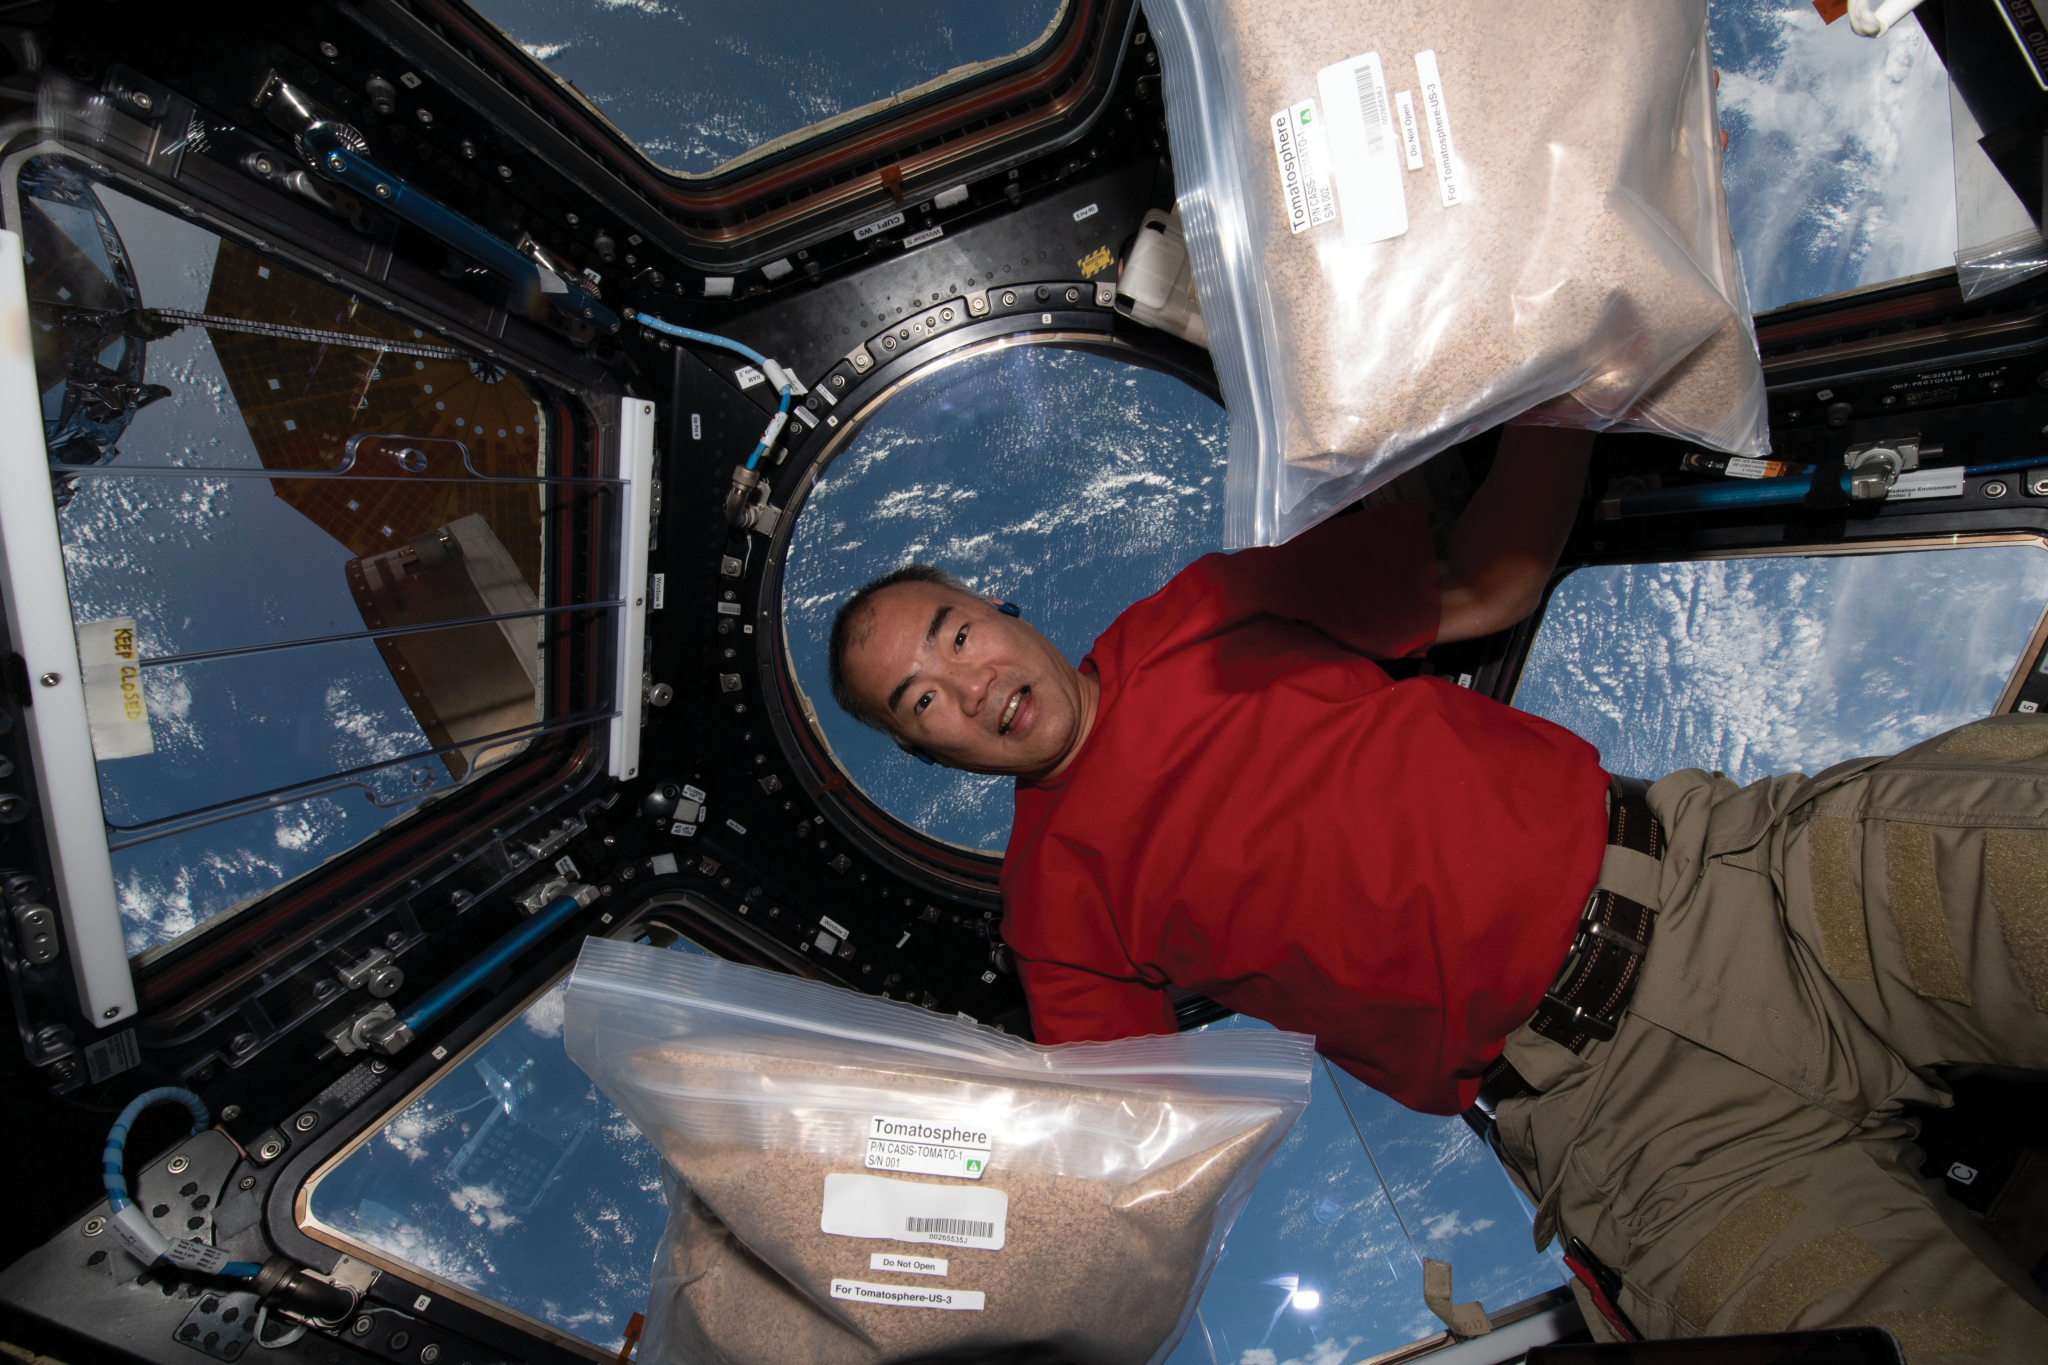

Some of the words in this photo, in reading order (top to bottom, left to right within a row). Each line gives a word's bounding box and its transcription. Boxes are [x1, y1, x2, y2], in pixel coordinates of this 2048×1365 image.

[1403, 104, 1412, 127] Open
[1407, 128, 1415, 143] Not
[1427, 83, 1453, 182] Tomatosphere-US-3
[1410, 144, 1417, 157] Do
[1276, 116, 1305, 231] Tomatosphere
[1297, 131, 1319, 206] CASIS-TOMATO-1
[1320, 186, 1332, 203] 002
[1447, 184, 1456, 201] For
[1310, 208, 1321, 223] P/N
[1323, 204, 1333, 219] S/N
[858, 216, 900, 237] CUP1_W5
[919, 229, 941, 243] Window
[1085, 253, 1105, 267] VACUUM
[748, 375, 760, 383] RAM
[114, 628, 136, 659] KEEP
[119, 666, 143, 721] CLOSED
[824, 919, 843, 935] Window
[874, 1119, 987, 1143] Tomatosphere
[870, 1142, 885, 1153] P/N
[888, 1143, 962, 1161] CASIS-TOMATO-1
[868, 1155, 883, 1165] S/N
[885, 1157, 900, 1168] 001
[1952, 1166, 1973, 1180] C
[113, 1225, 120, 1233] TO
[121, 1233, 144, 1254] WINDOW
[929, 1234, 968, 1244] 00265535J
[897, 1260, 911, 1268] Not
[914, 1261, 935, 1271] Open
[835, 1285, 852, 1294] For
[855, 1287, 952, 1304] Tomatosphere-US-3
